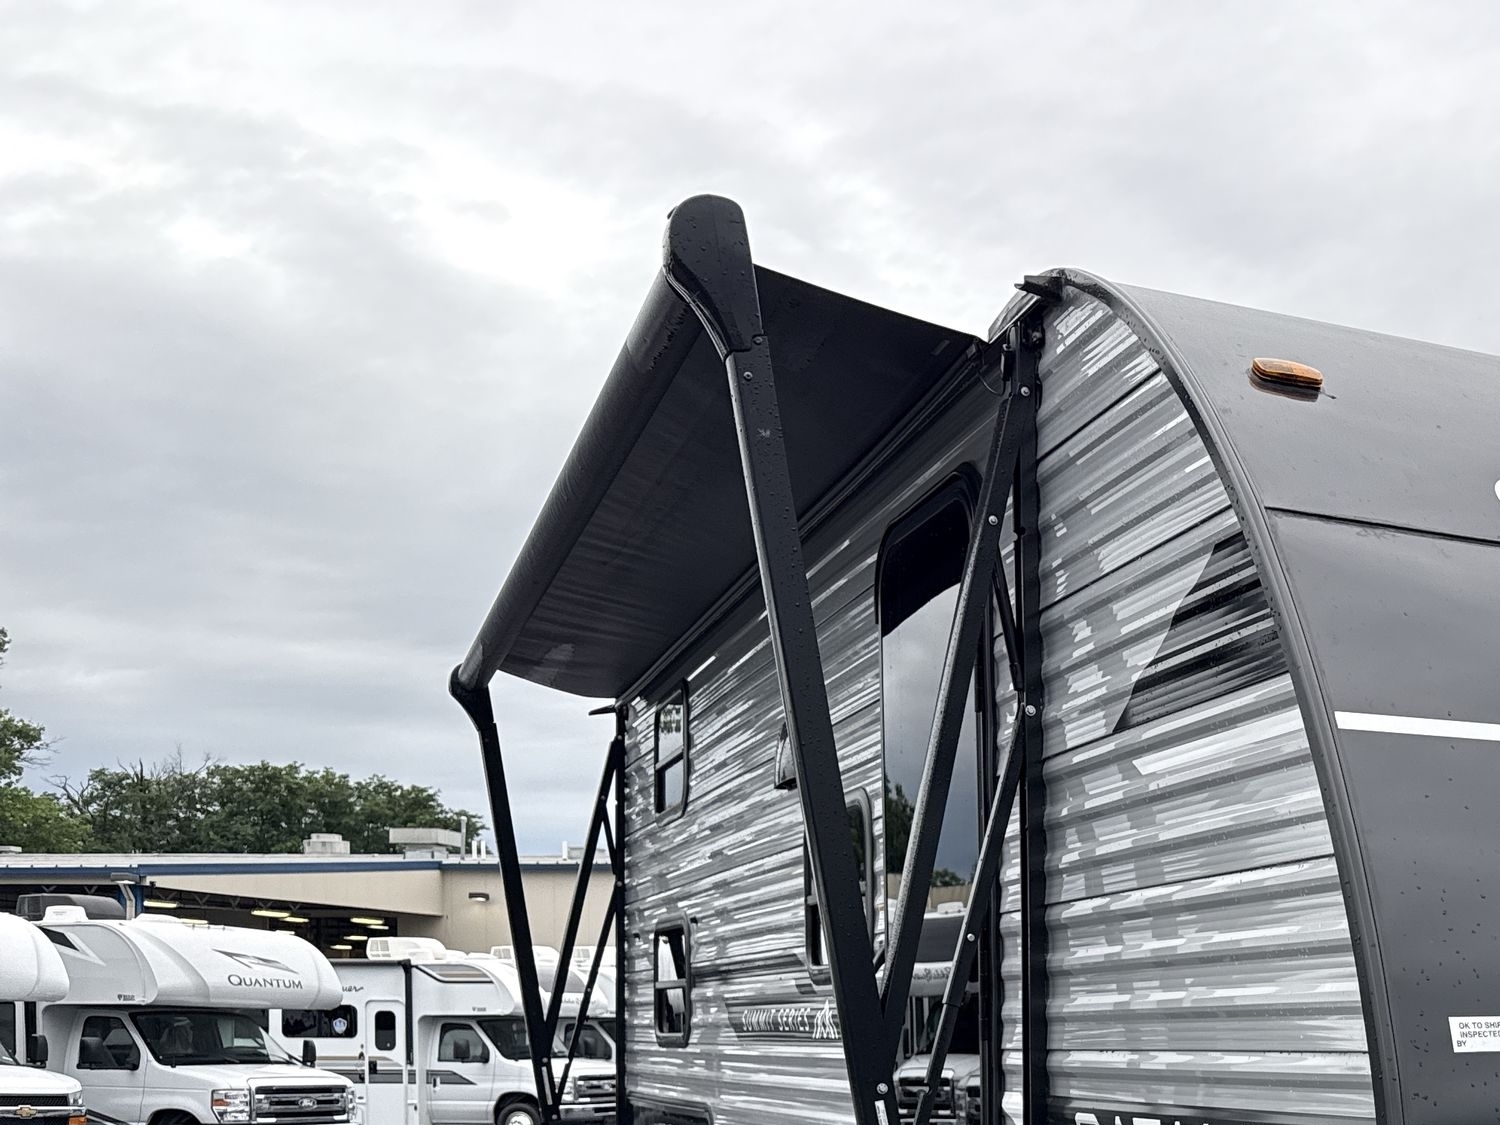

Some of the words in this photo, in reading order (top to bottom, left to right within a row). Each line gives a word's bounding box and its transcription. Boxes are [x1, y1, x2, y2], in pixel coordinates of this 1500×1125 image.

[227, 973, 303, 990] QUANTUM
[742, 1008, 776, 1032] SUMMIT
[777, 1007, 811, 1032] SERIES
[1458, 1022, 1471, 1030] OK
[1456, 1040, 1467, 1048] BY
